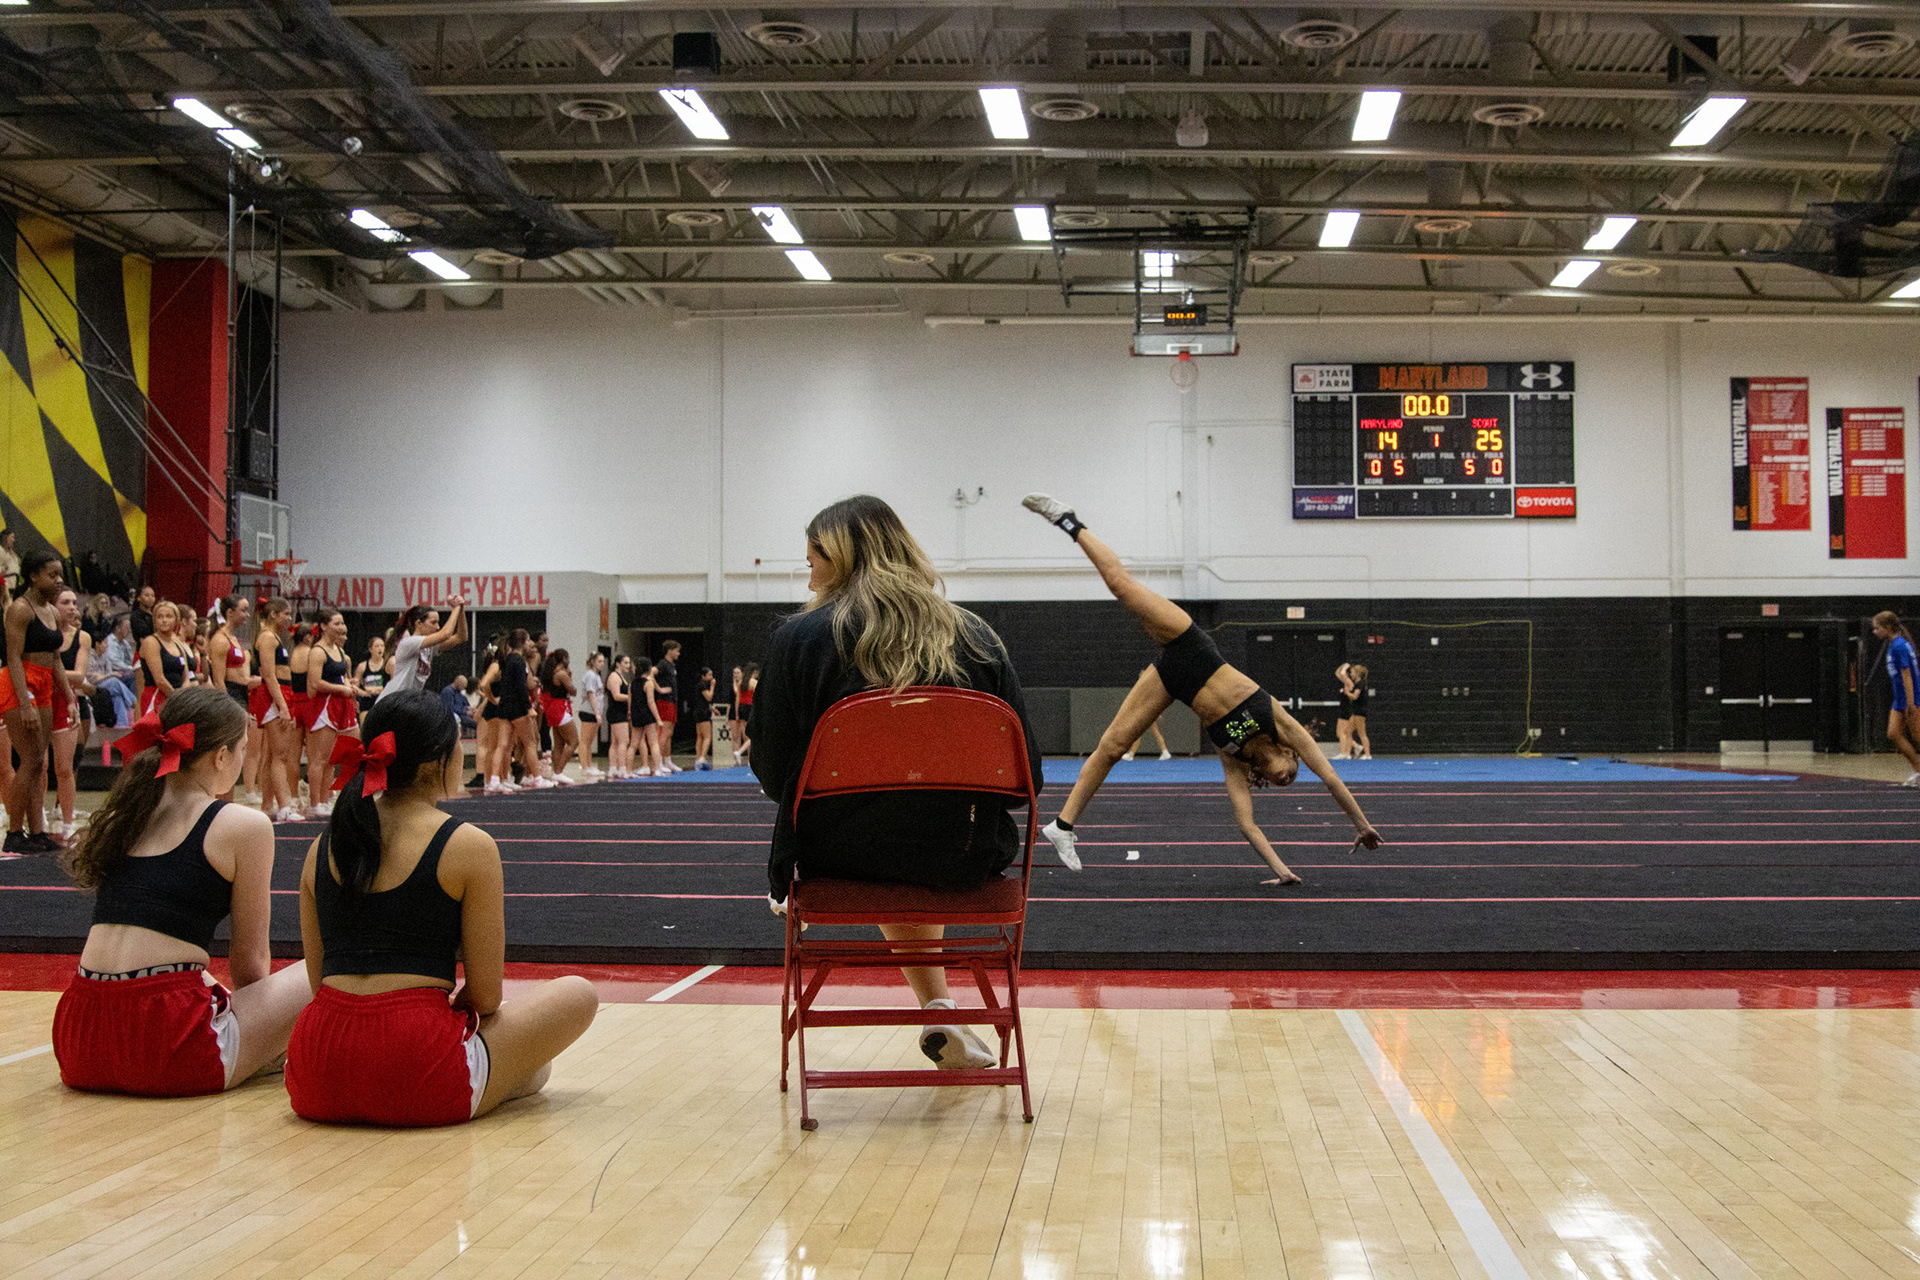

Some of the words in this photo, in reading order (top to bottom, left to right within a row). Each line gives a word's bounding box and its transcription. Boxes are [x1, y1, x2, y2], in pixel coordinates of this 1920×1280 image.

[1379, 366, 1488, 389] MARYLAND
[1404, 395, 1449, 416] 00.0
[1360, 418, 1403, 429] MARYLAND
[1471, 418, 1499, 428] SCOUT
[1379, 431, 1398, 450] 14
[1476, 430, 1502, 451] 25
[1371, 459, 1382, 476] 0
[1393, 459, 1404, 476] 5
[1464, 459, 1475, 476] 5
[1491, 459, 1503, 476] 0
[1533, 497, 1574, 506] TOYOTA
